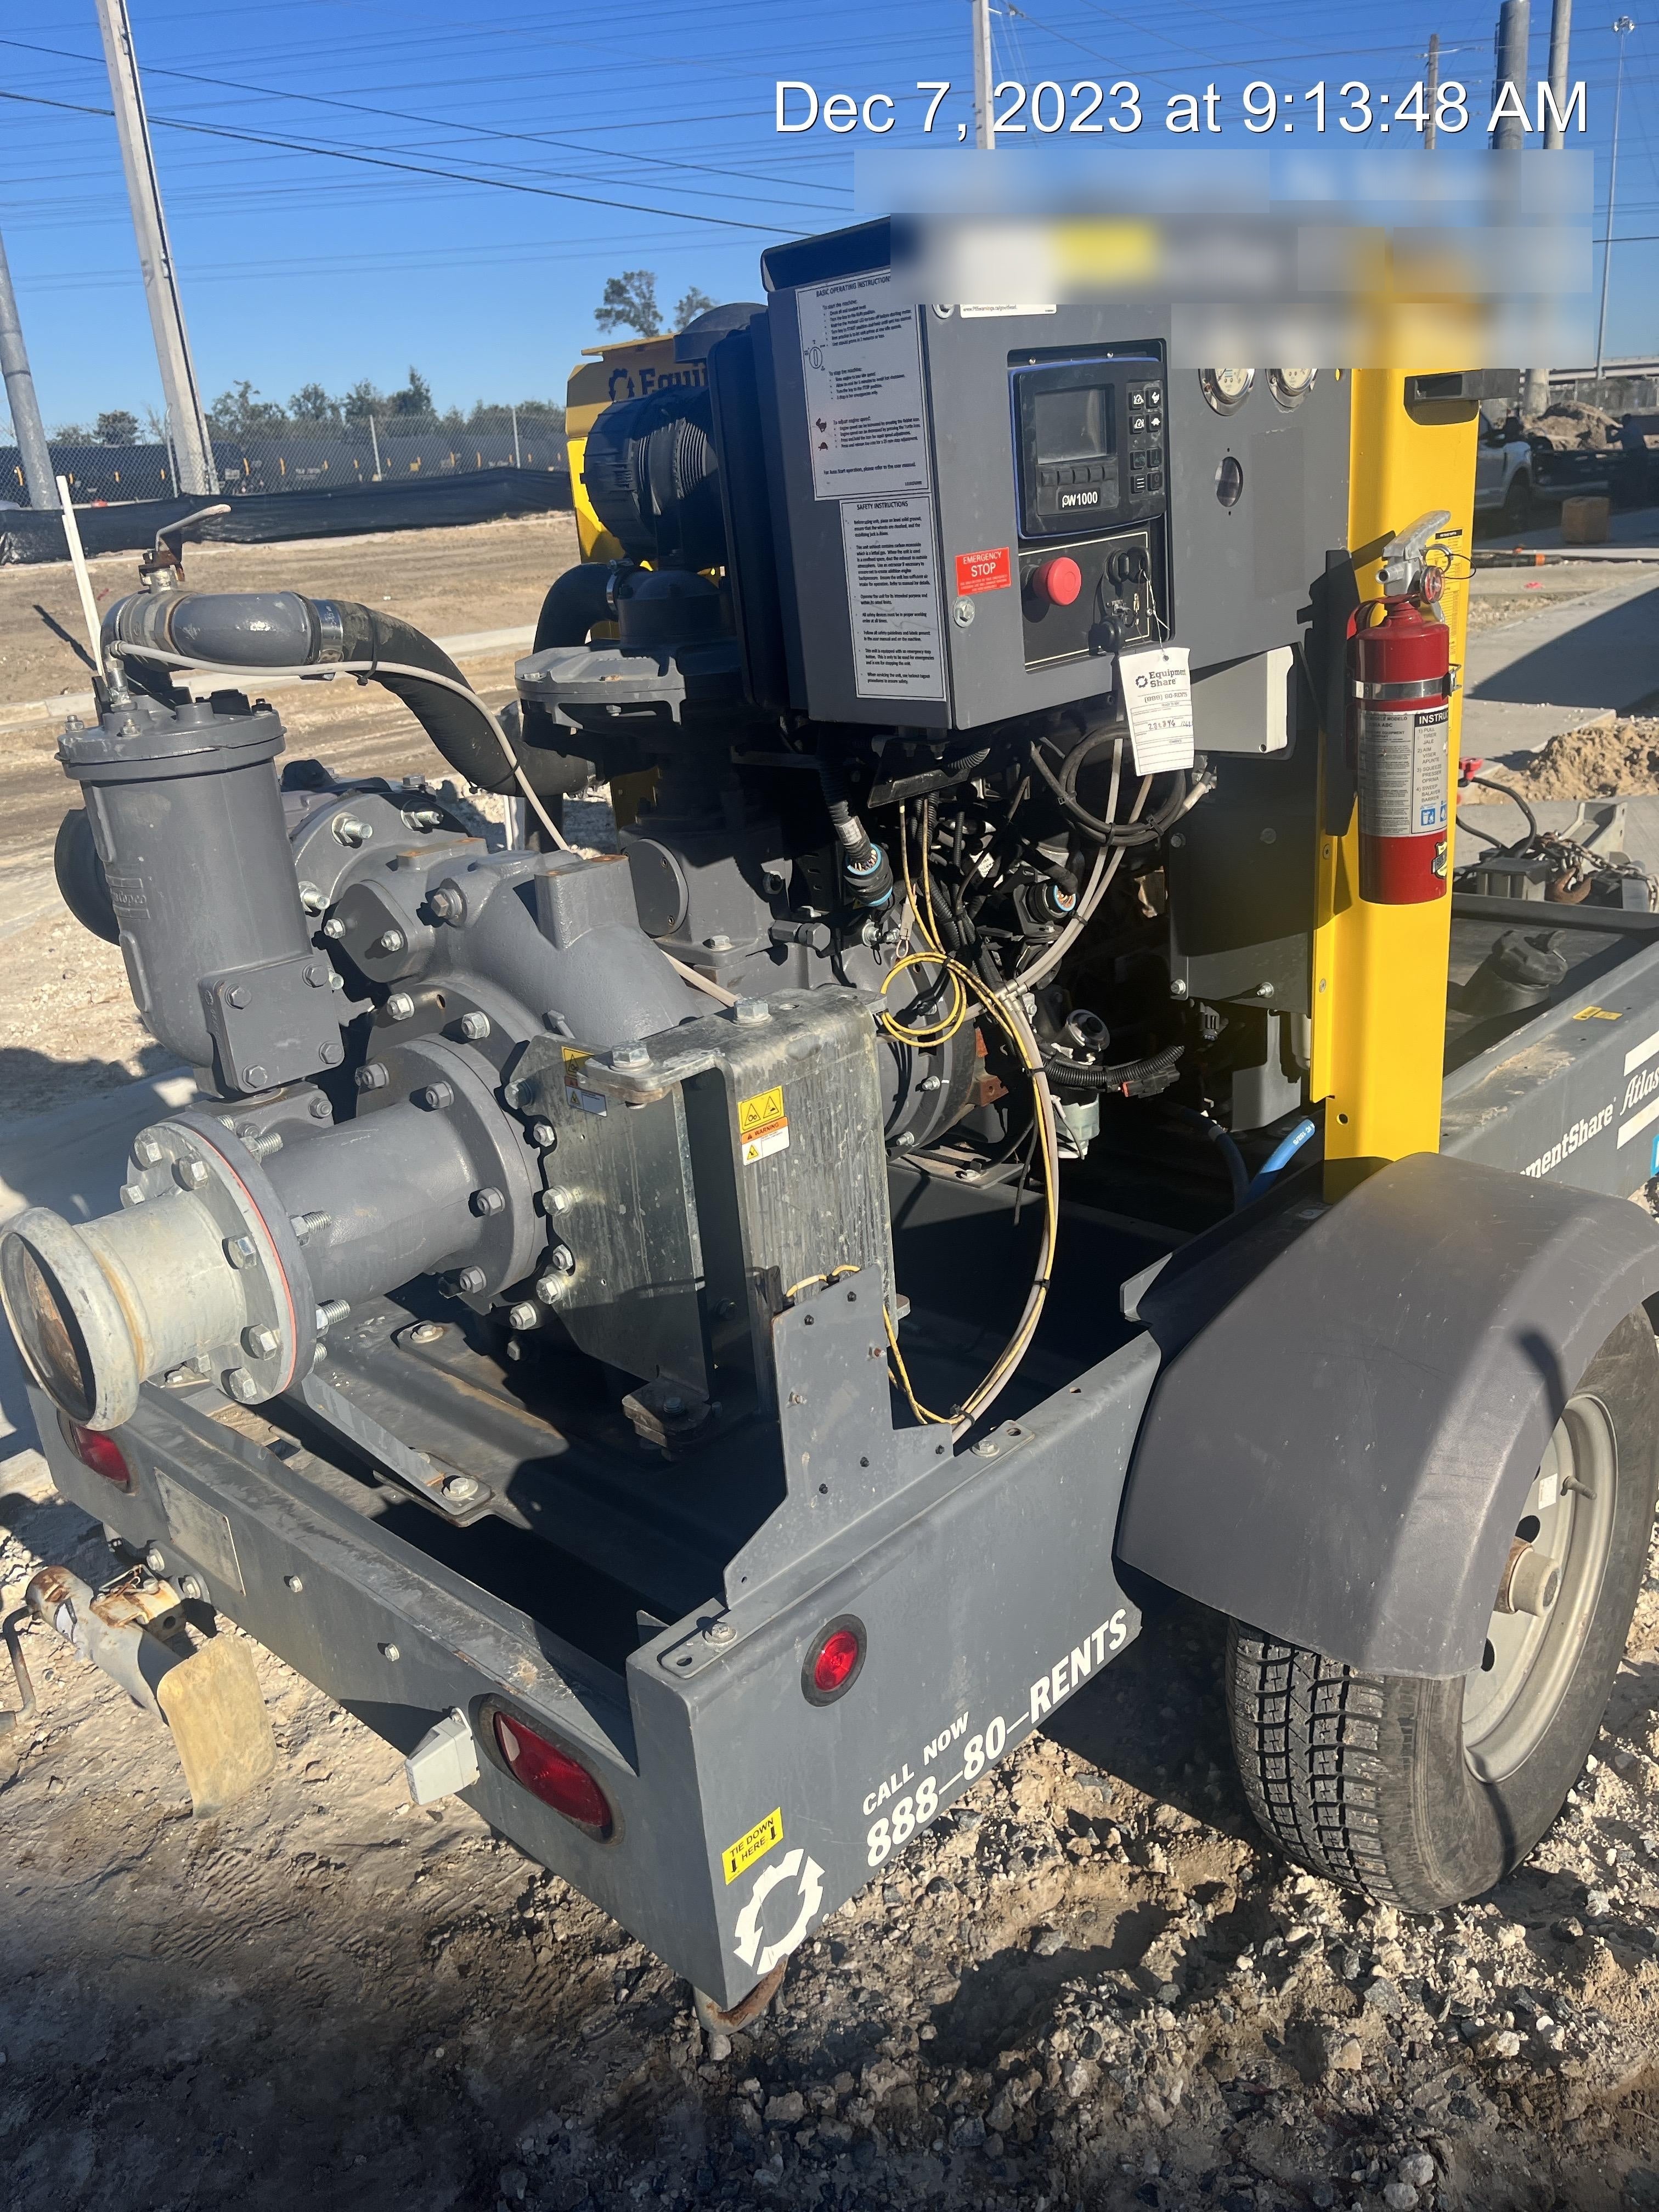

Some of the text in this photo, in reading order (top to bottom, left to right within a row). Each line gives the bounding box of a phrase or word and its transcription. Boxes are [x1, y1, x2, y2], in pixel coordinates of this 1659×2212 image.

[963, 551, 1002, 565] EMERGENCY
[971, 562, 996, 577] STOP
[1150, 678, 1176, 688] Share
[754, 1122, 779, 1136] WARNING
[1520, 1067, 1659, 1178] mentShare Atlas
[863, 1712, 969, 1815] CALL NOW
[730, 1818, 774, 1857] TIE DOWN
[742, 1836, 766, 1861] HERE
